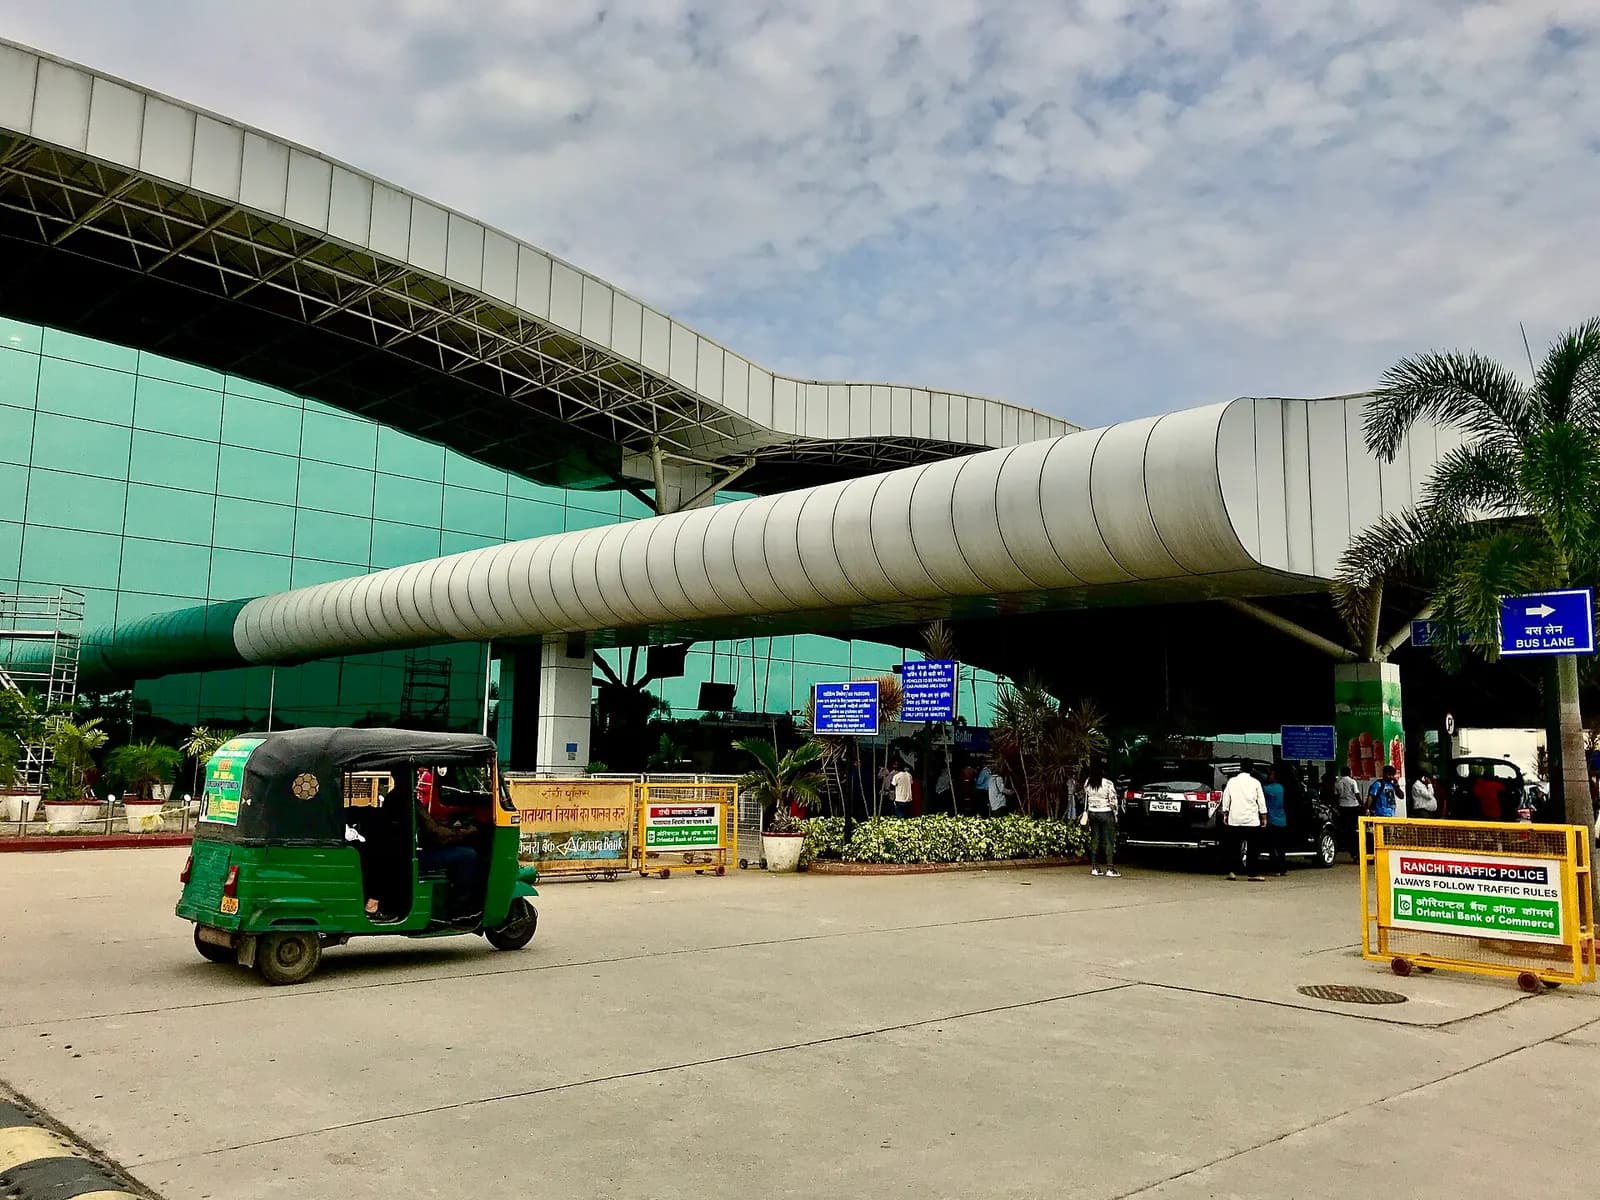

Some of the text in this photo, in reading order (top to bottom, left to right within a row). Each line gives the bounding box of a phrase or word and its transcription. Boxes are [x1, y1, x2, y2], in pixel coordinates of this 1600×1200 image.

[1524, 623, 1563, 635] बस लेन
[1516, 637, 1575, 648] BUS LANE
[579, 807, 589, 822] का
[590, 807, 611, 823] पालन
[577, 836, 624, 852] Canara Bank
[1403, 861, 1545, 881] RANCHI TRAFFIC POLICE
[1394, 877, 1558, 898] ALWAYS FOLLOW TRAFFIC RULES
[1416, 897, 1465, 910] ओरियन्टल
[1470, 901, 1487, 912] बैंक
[1416, 908, 1555, 929] Oriental Bank of Commerce
